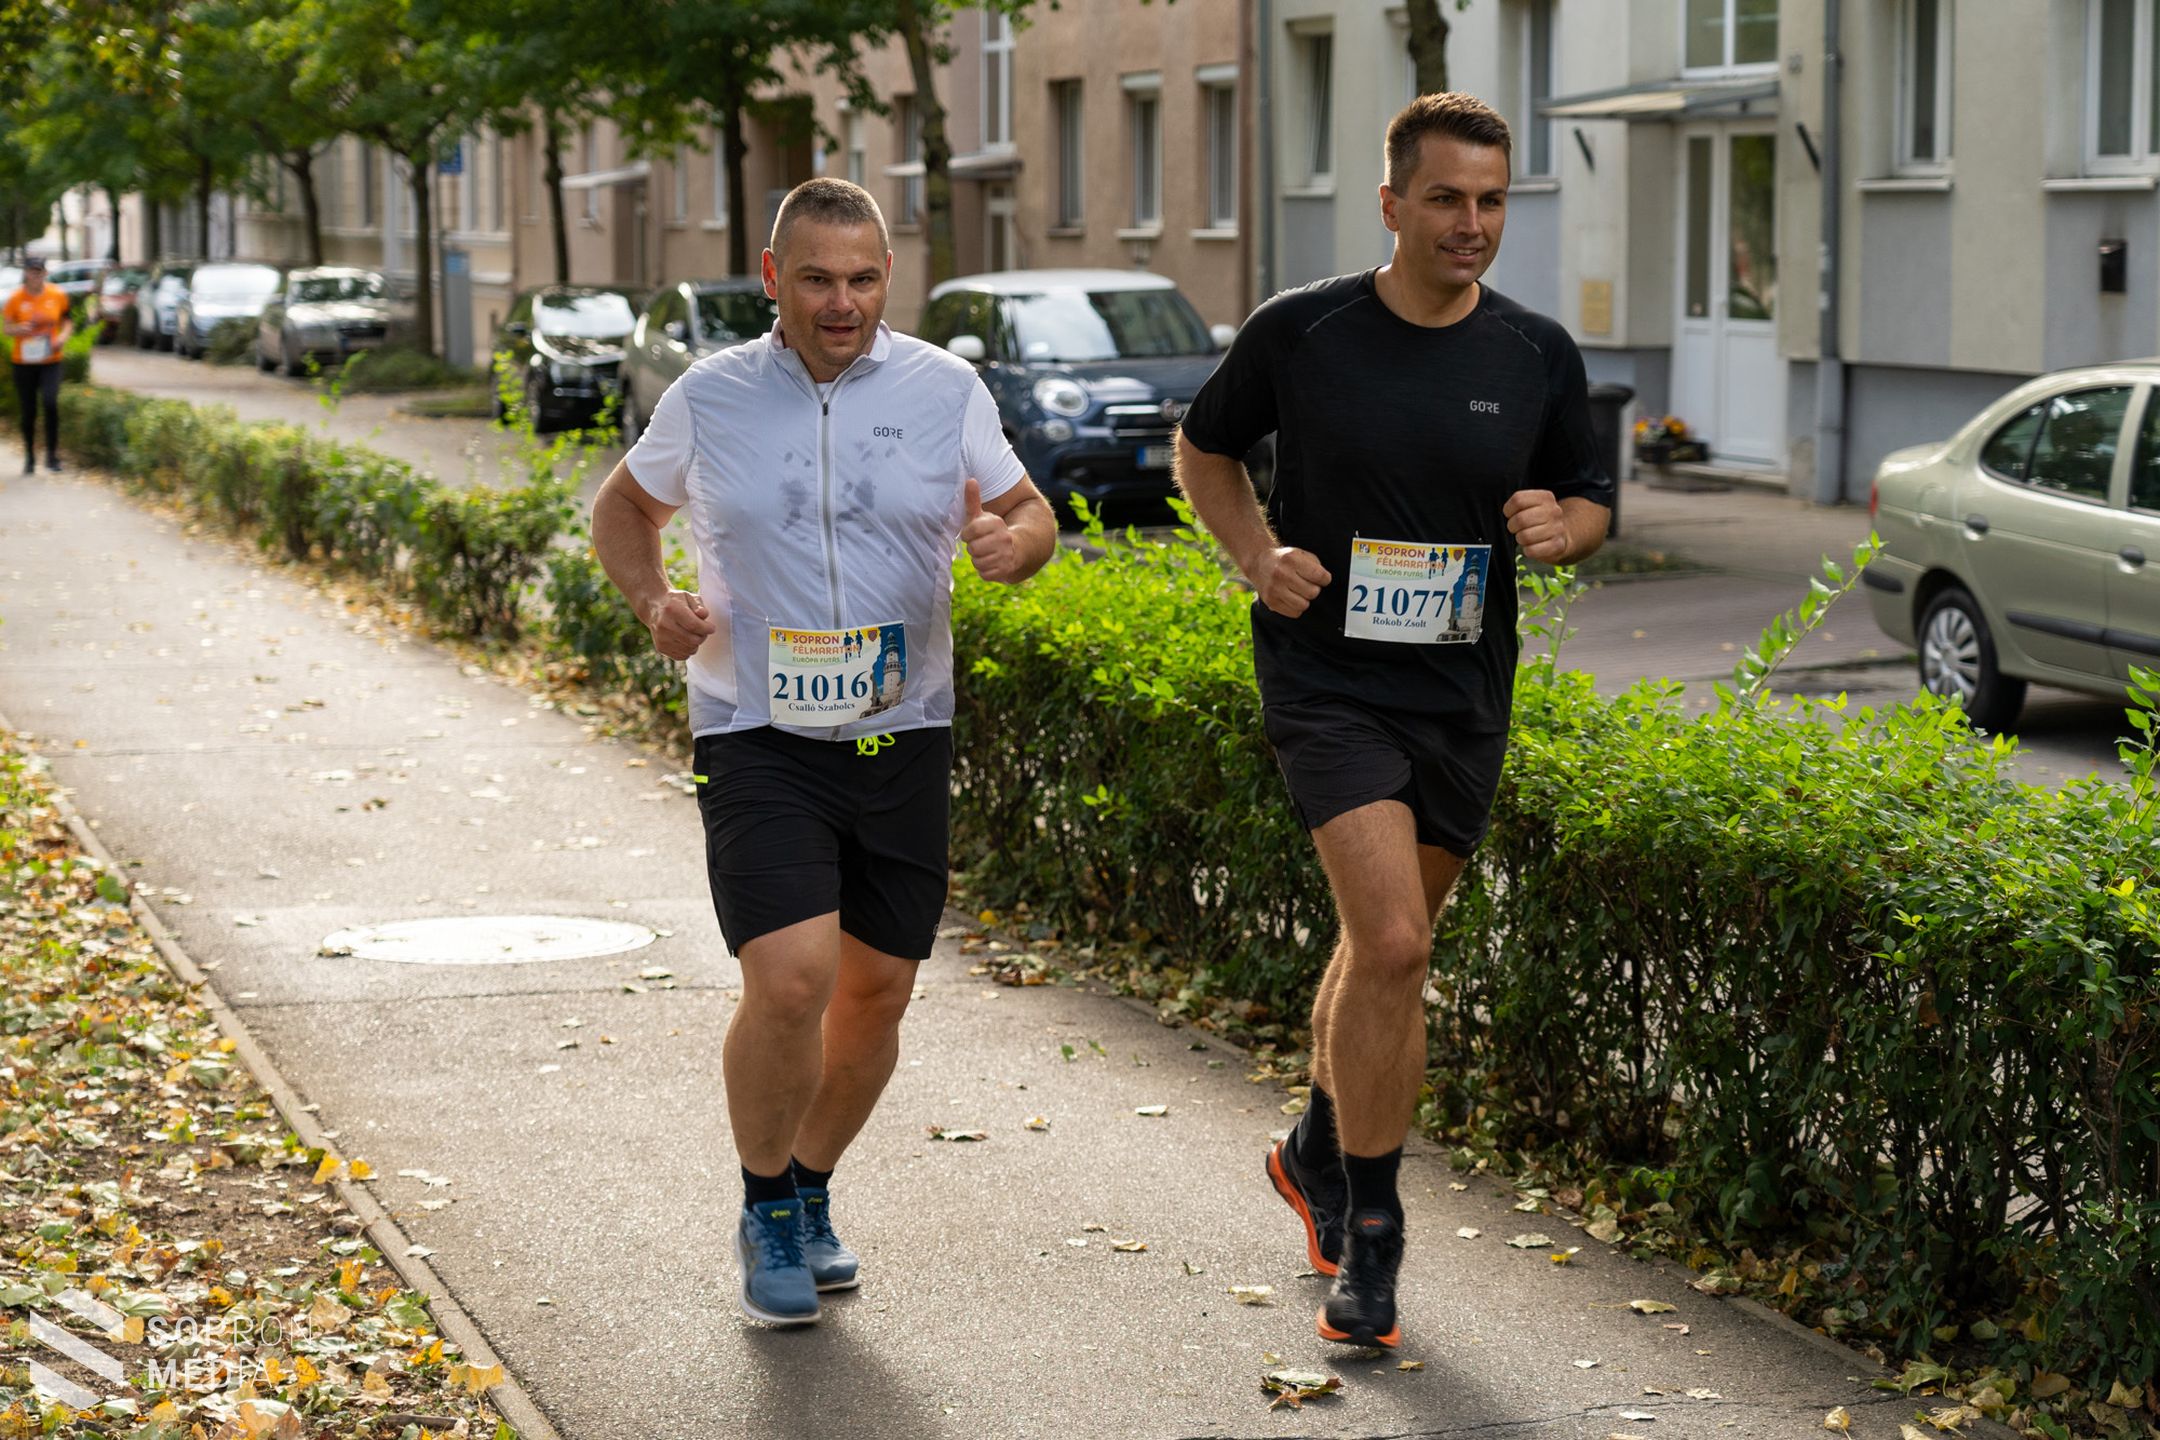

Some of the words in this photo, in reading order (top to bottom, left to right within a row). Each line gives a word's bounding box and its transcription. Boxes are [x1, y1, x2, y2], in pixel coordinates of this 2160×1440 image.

[1470, 400, 1500, 414] GORE
[873, 426, 903, 439] GORE
[1377, 546, 1426, 558] SOPRON
[1350, 584, 1449, 617] 21077
[1372, 616, 1402, 627] Rokob
[1404, 617, 1427, 628] Zsolt
[792, 635, 840, 645] SOPRON
[772, 670, 868, 702] 21016
[788, 702, 816, 712] Csalló
[817, 702, 855, 712] Szabolcs
